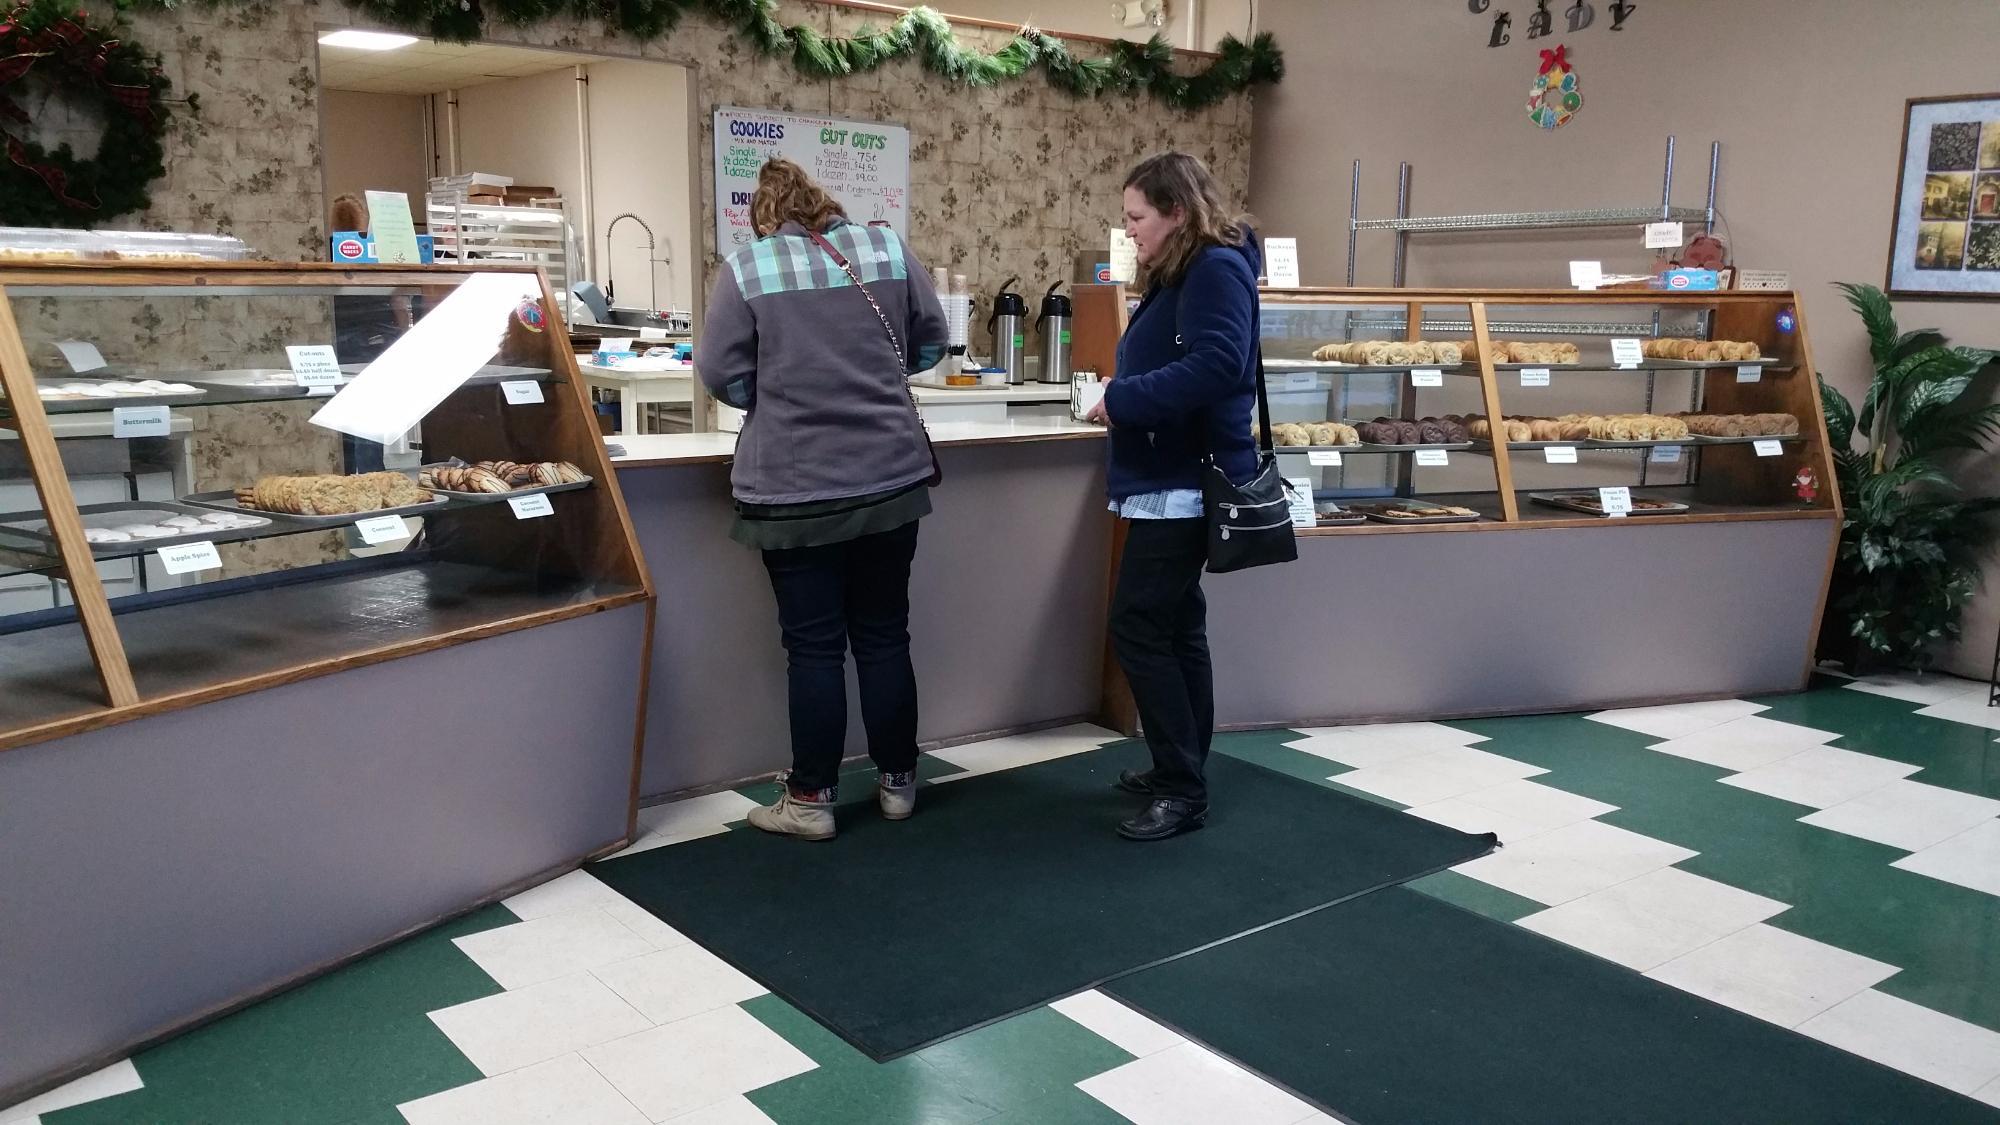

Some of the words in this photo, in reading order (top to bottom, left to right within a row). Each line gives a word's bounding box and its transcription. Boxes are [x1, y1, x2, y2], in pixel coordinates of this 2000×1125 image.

[730, 120, 784, 139] COOKIES
[820, 127, 848, 145] CUT
[852, 131, 887, 150] OUTS
[729, 167, 758, 178] dozen
[122, 418, 162, 426] Buttermilk
